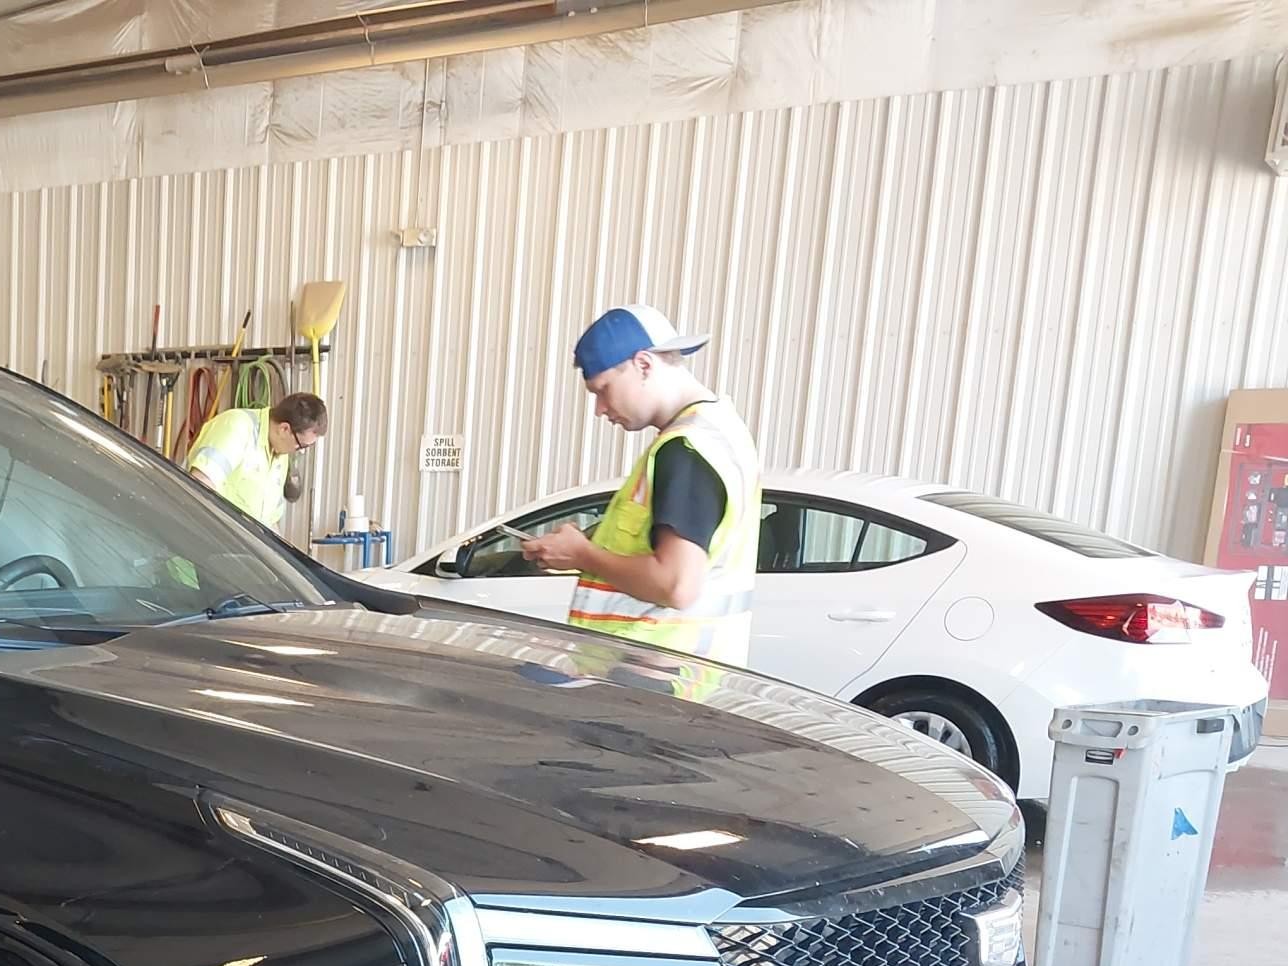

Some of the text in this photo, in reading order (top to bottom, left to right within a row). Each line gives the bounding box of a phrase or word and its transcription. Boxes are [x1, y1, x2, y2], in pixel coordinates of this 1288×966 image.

[434, 438, 455, 447] SPILL
[425, 447, 461, 457] SORBENT
[425, 458, 460, 467] STORAGE
